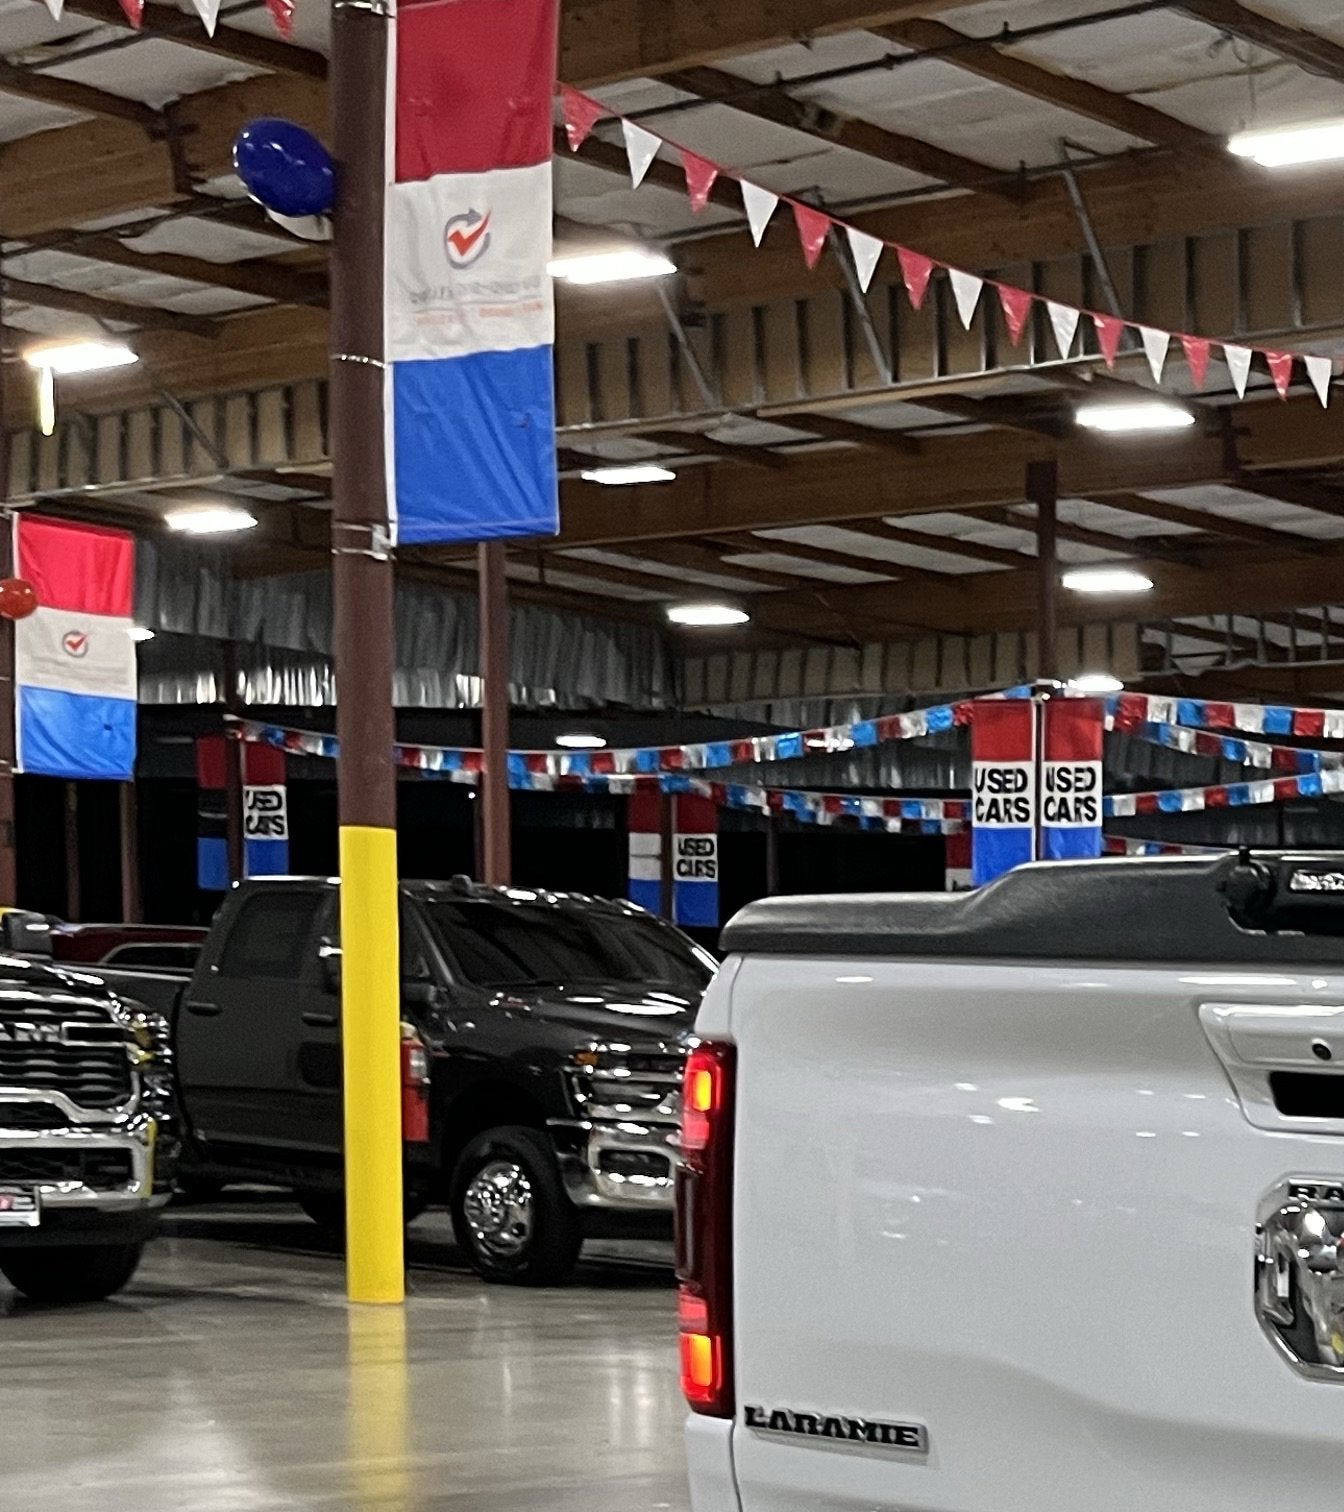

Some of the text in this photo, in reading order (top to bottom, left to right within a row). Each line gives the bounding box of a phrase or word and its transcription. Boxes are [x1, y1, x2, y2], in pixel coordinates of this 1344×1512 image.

[975, 768, 1028, 794] USED
[1046, 767, 1096, 793] USED
[975, 797, 1030, 823] CARS
[1044, 796, 1097, 822] CARS
[744, 1405, 922, 1447] LARAMIE
